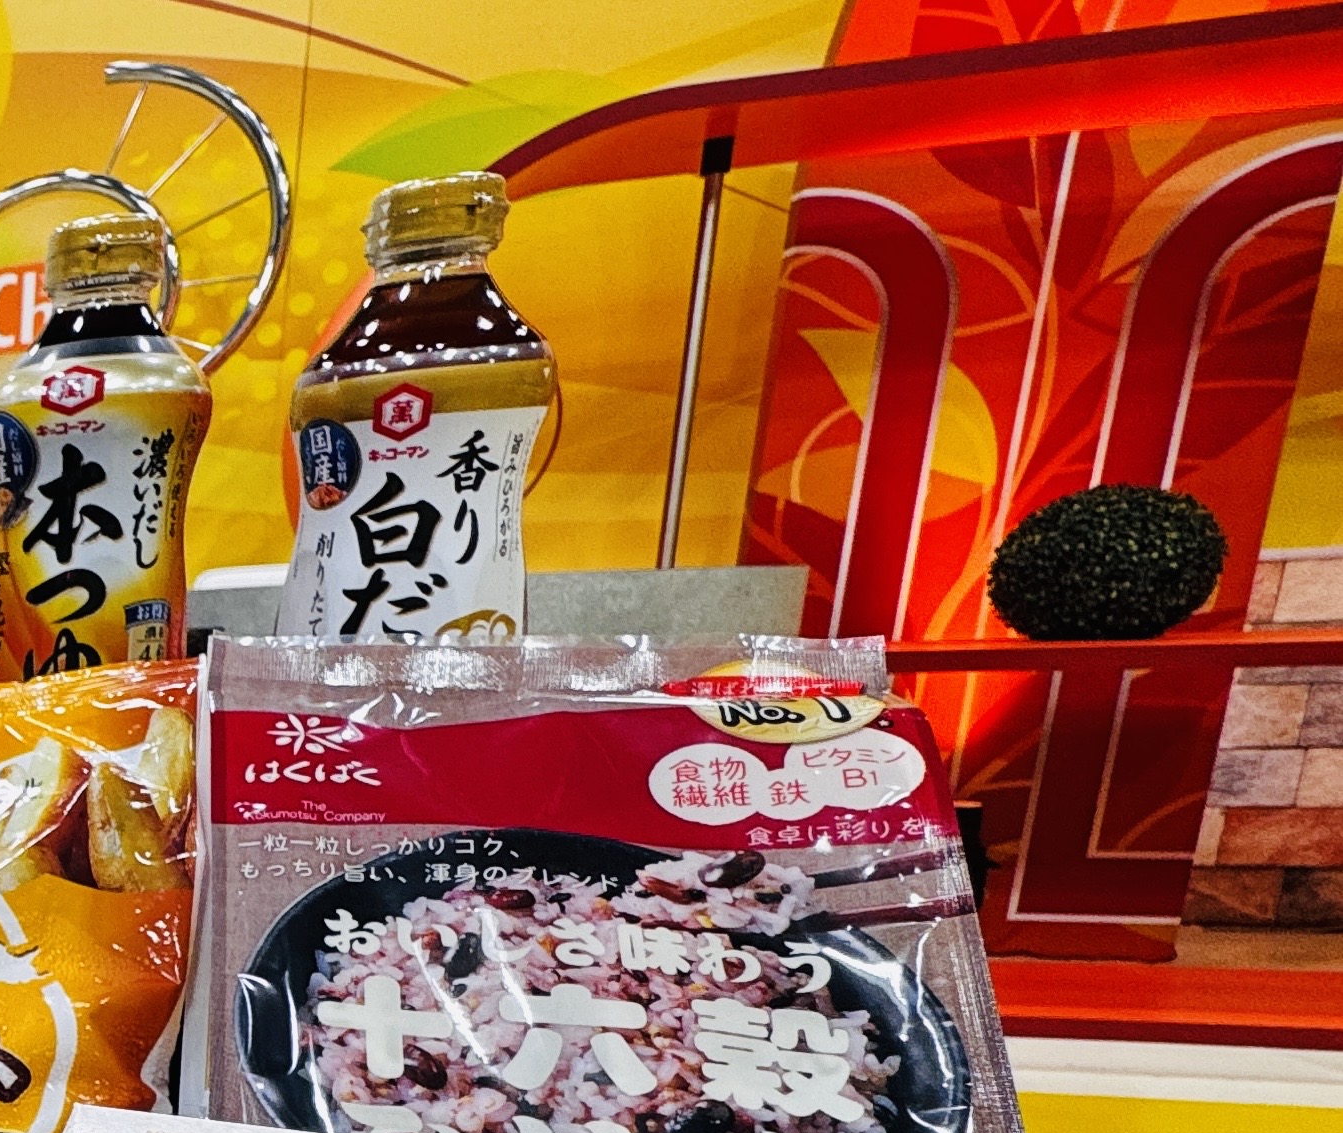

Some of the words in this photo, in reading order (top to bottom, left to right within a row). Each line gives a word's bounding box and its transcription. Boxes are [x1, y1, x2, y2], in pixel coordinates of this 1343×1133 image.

[308, 424, 335, 485] 国産
[368, 445, 430, 462] キッコーマン
[435, 429, 500, 566] 香り
[669, 756, 747, 784] 食物
[801, 747, 907, 768] ビタミン
[244, 757, 383, 787] はくばく
[672, 782, 751, 808] 繊維
[768, 780, 811, 807] 鉄
[323, 809, 387, 825] Company
[237, 835, 523, 860] 一粒一粒しっかりコク、
[324, 906, 831, 995] おいしさ味わう
[318, 974, 870, 1121] 十六穀
